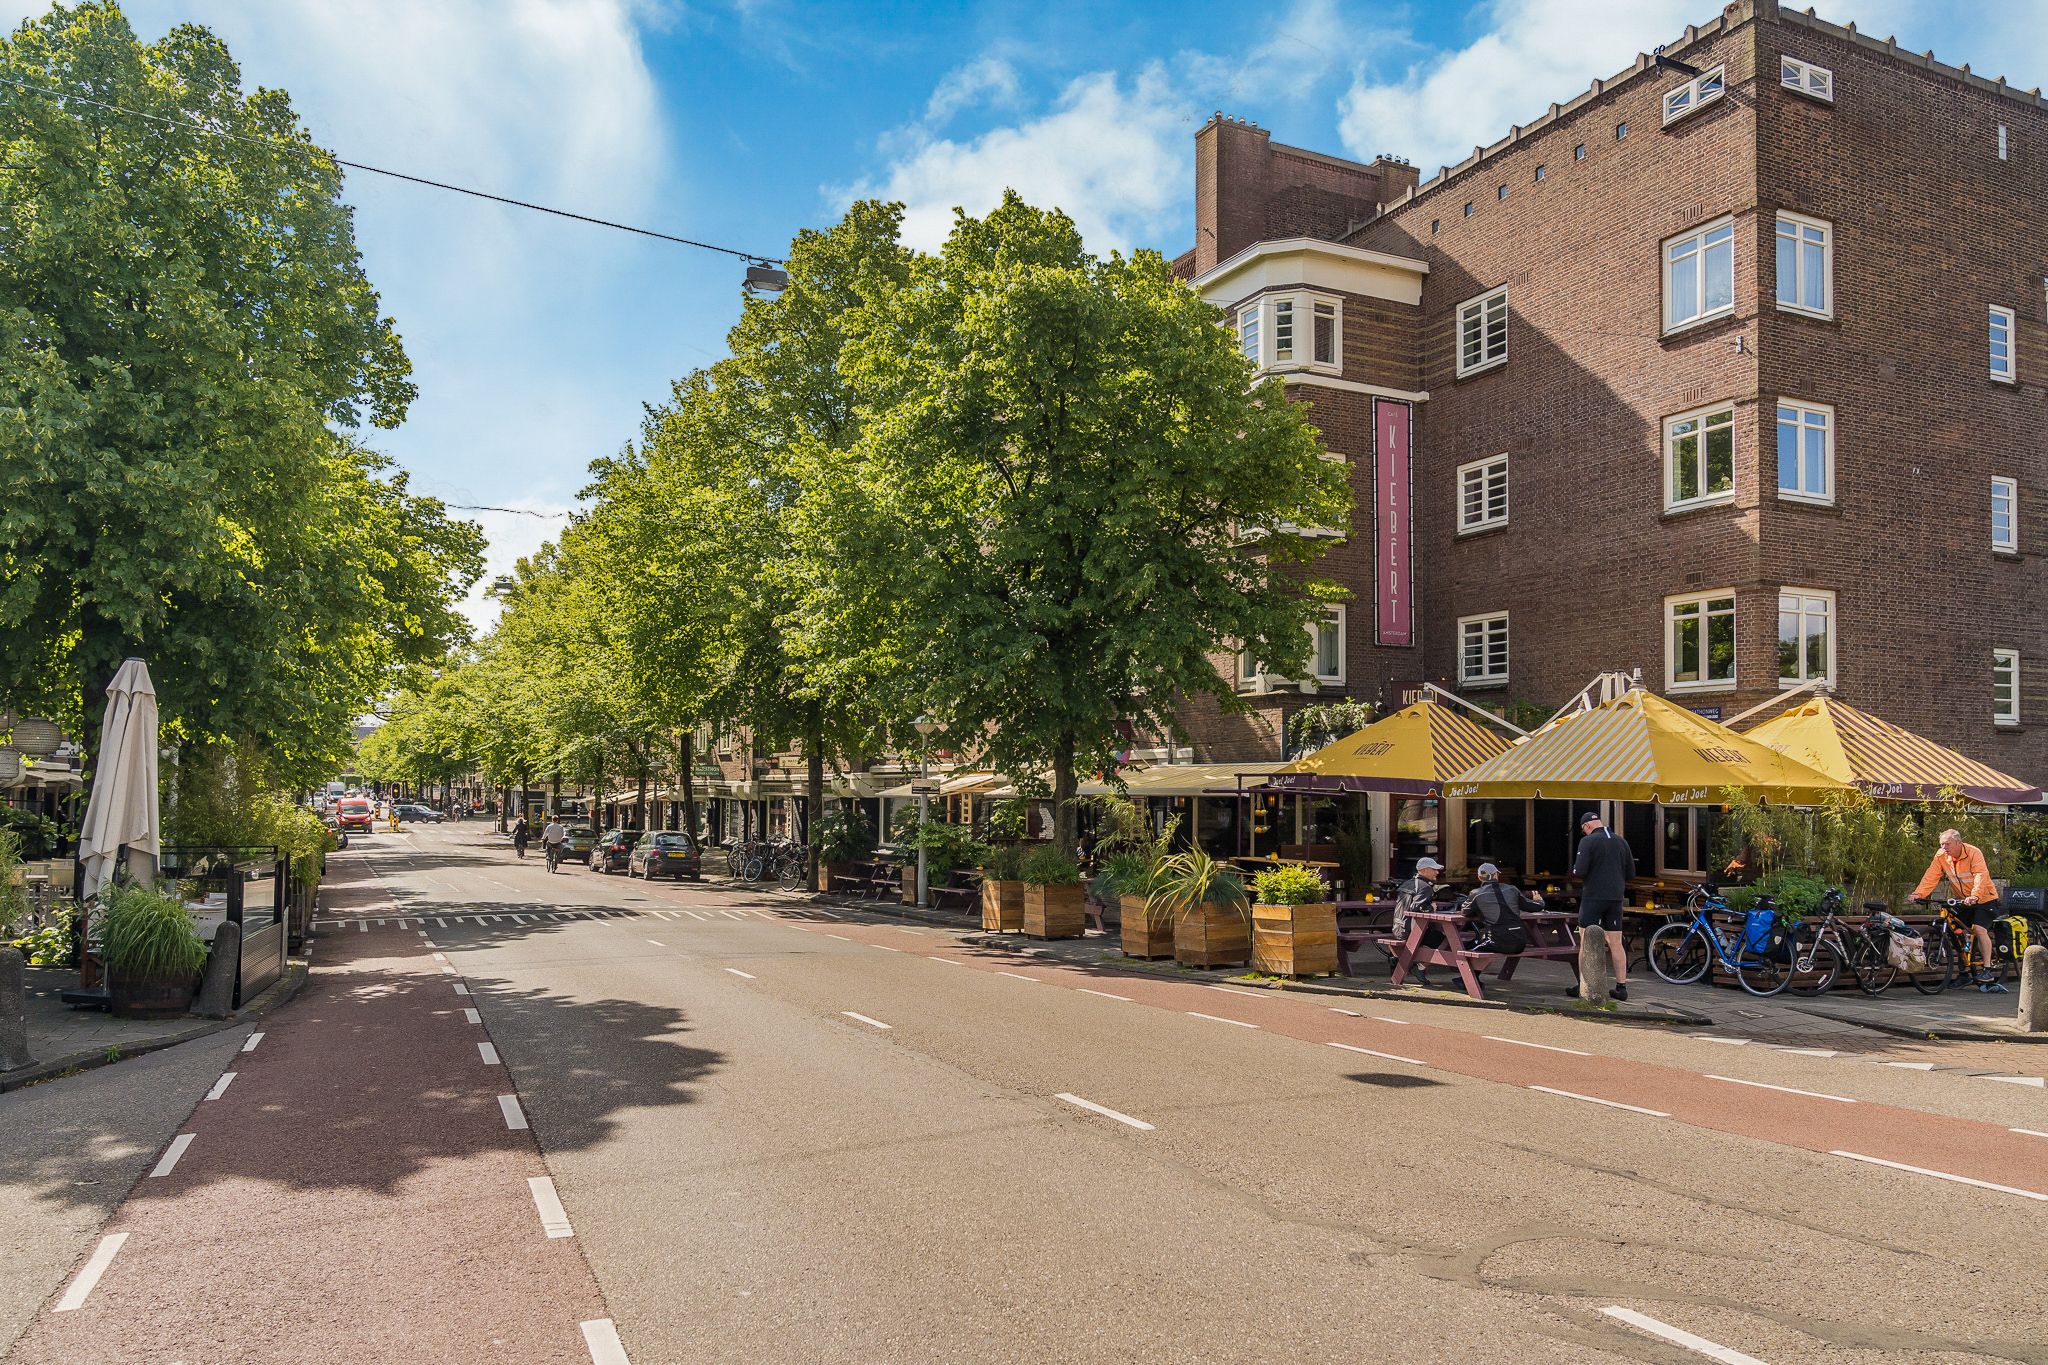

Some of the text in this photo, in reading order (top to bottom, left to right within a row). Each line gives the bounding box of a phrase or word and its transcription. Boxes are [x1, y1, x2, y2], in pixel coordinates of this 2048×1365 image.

[1284, 775, 1296, 785] Joe!
[1449, 784, 1480, 798] Joe! Joe!
[1669, 787, 1708, 803] Joe! Joe!
